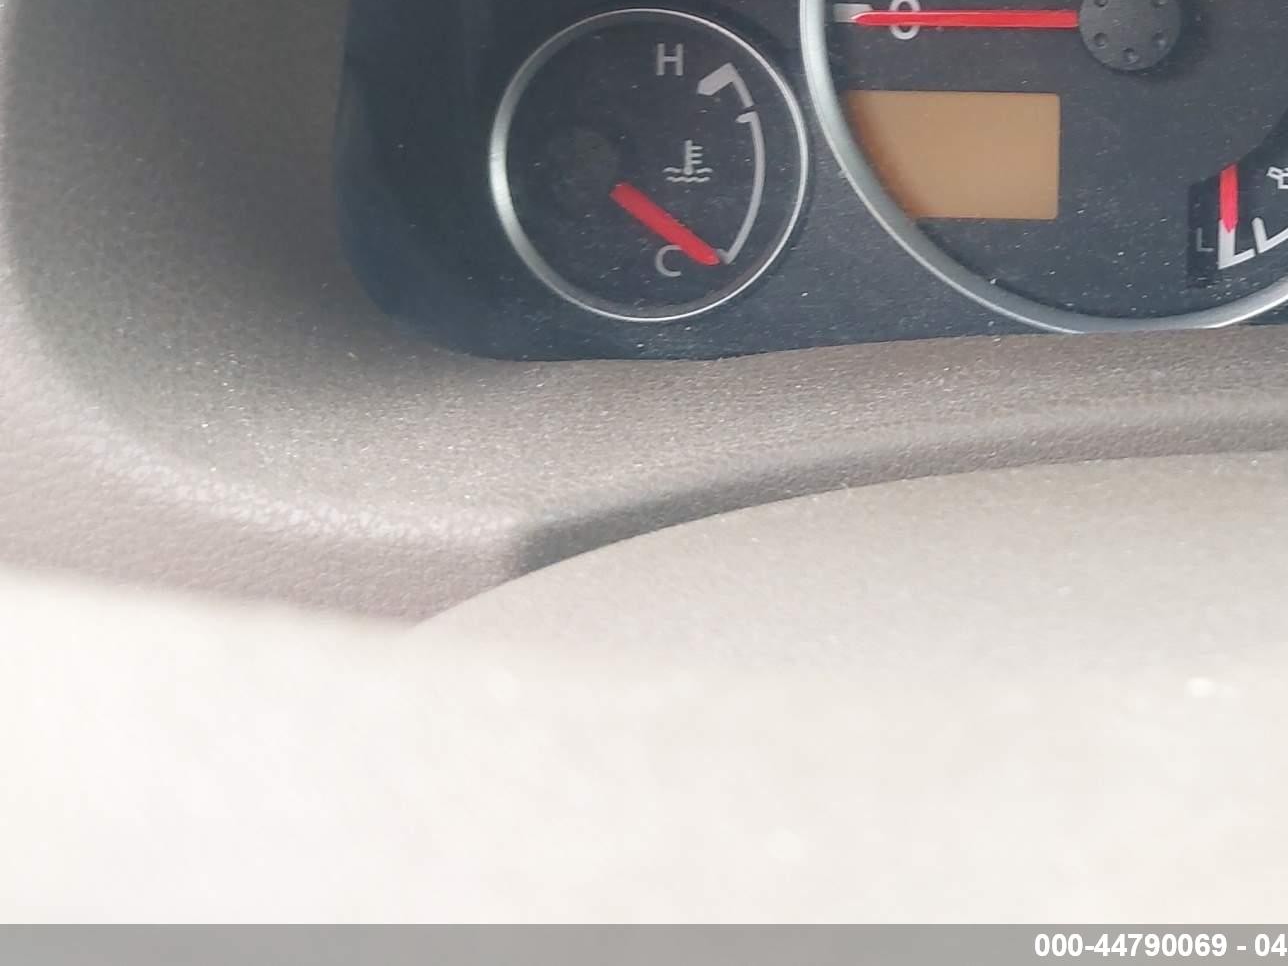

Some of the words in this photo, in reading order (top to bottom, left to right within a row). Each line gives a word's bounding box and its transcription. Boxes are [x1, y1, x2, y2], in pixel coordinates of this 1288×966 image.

[656, 45, 683, 75] H
[1197, 227, 1214, 251] L
[655, 245, 682, 276] C
